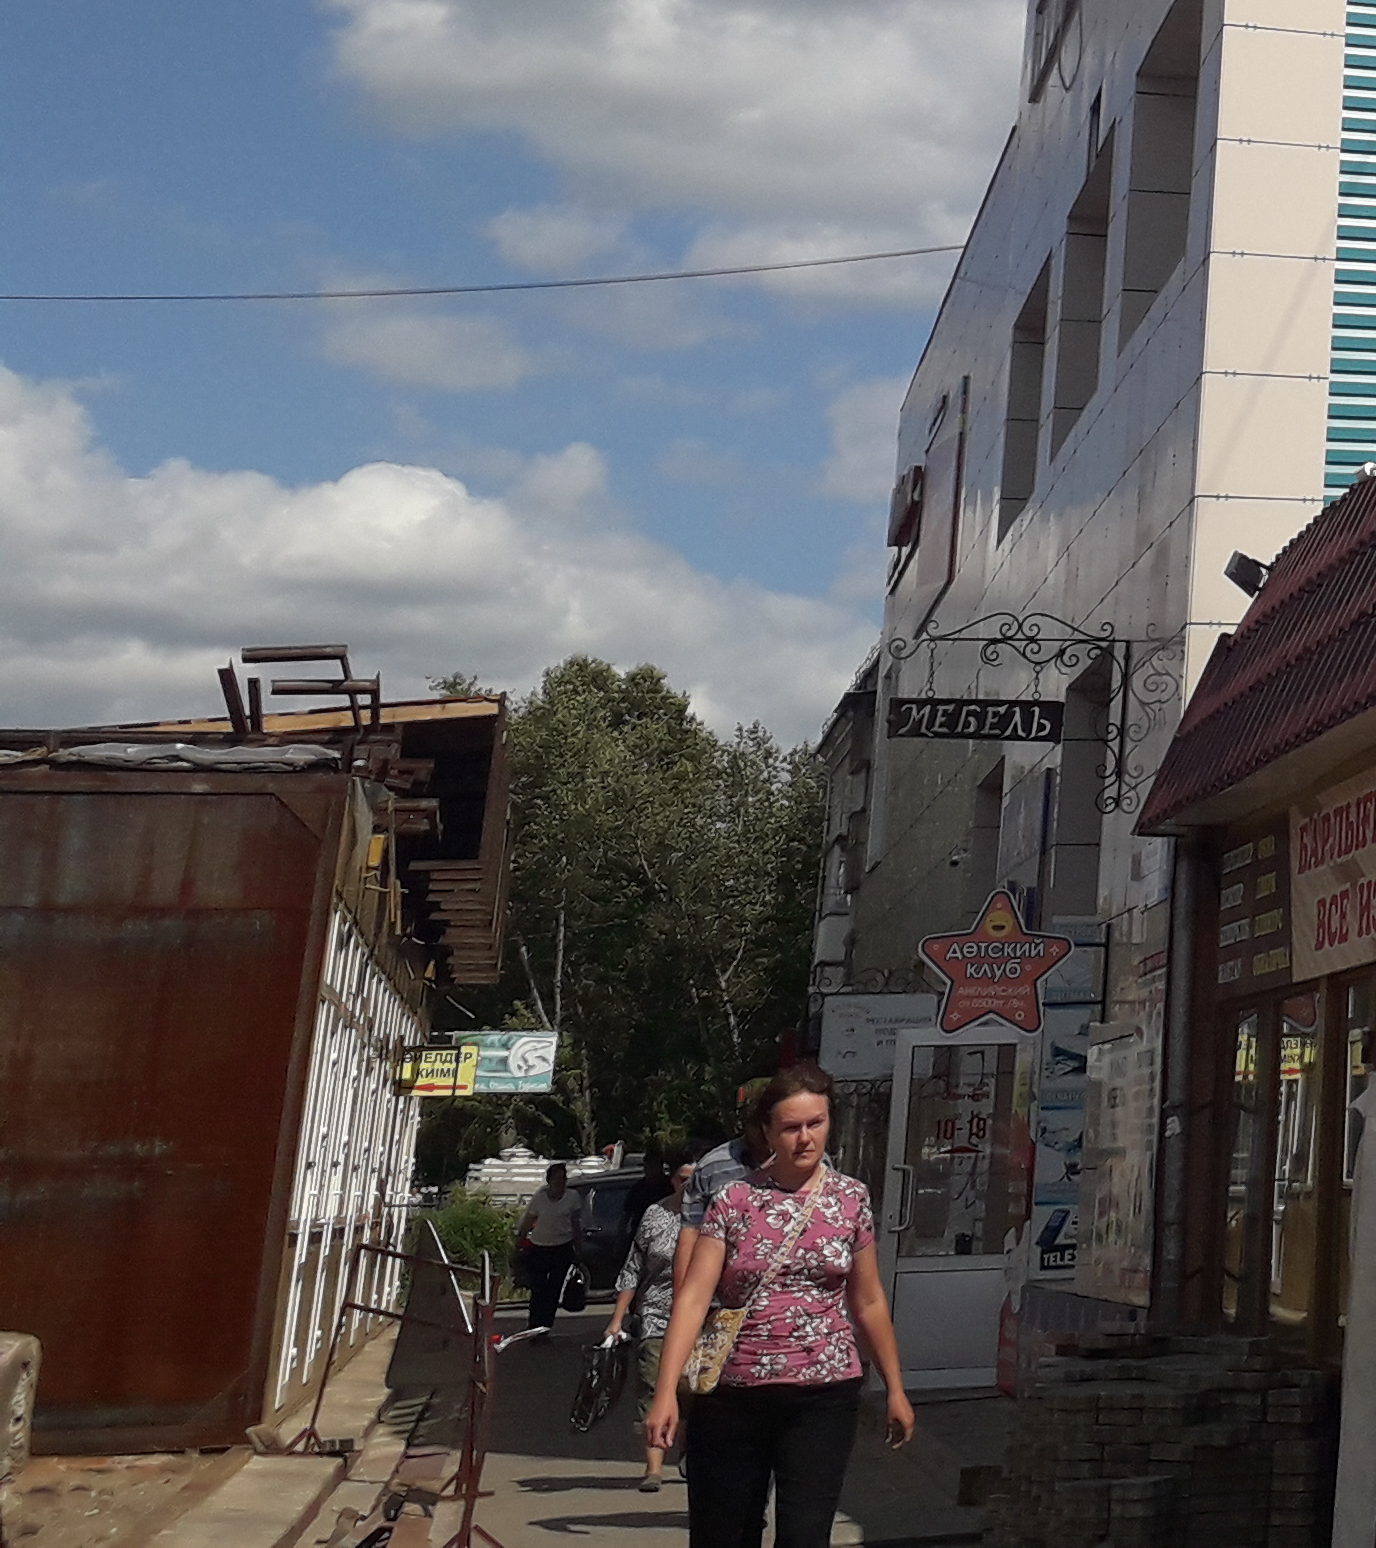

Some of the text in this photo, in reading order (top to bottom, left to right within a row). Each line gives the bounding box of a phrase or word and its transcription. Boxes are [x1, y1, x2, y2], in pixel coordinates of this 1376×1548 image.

[896, 703, 1052, 741] МЕБЕЛЬ
[1314, 888, 1350, 952] ВСЕ
[1043, 1249, 1077, 1266] TELE
